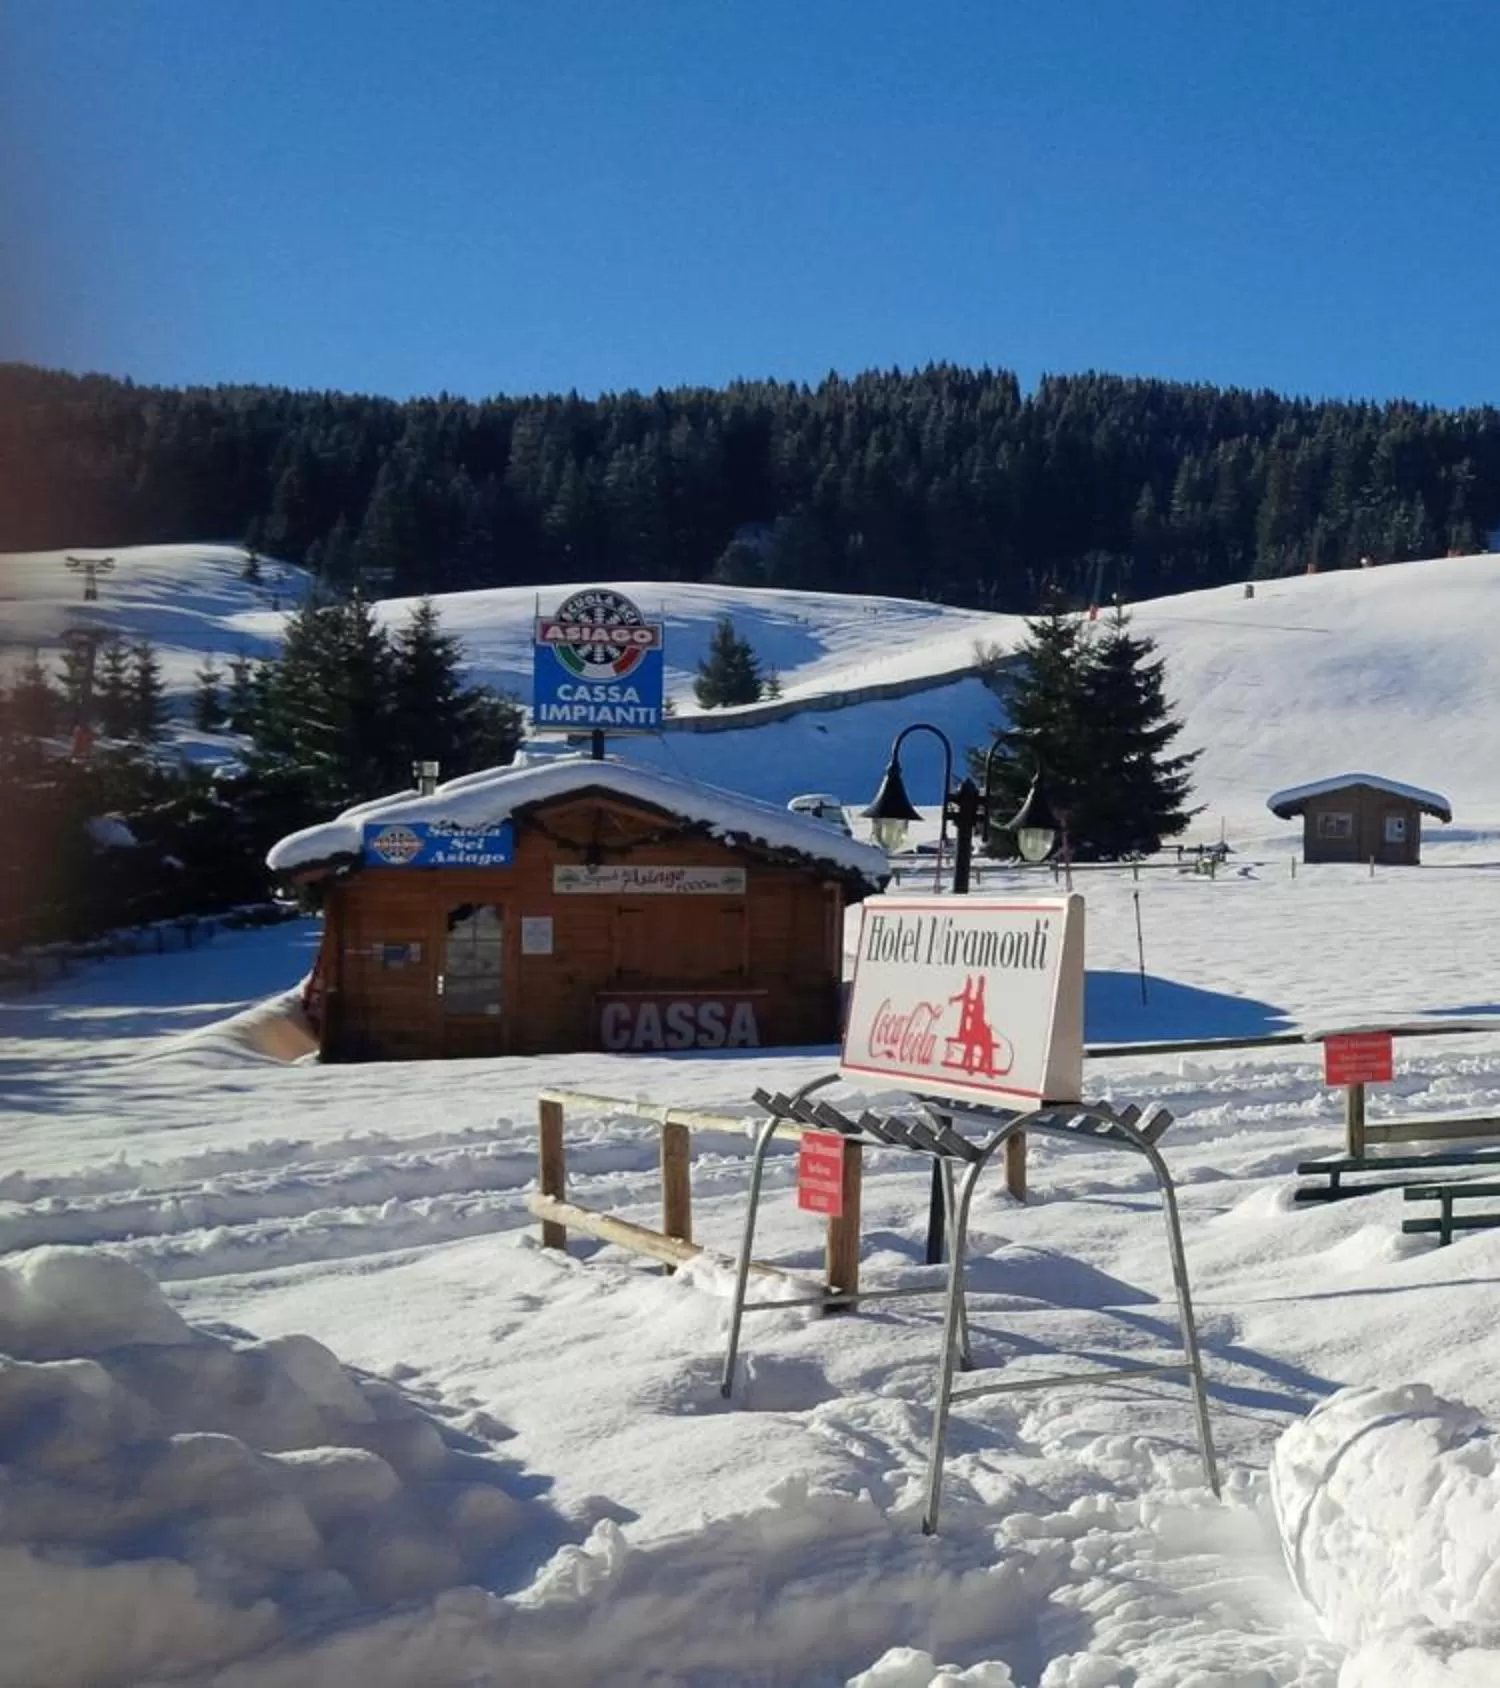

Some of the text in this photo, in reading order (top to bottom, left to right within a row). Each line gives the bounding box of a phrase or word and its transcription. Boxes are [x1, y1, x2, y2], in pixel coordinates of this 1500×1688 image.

[544, 625, 654, 643] ASIAGO
[556, 683, 641, 703] CASSA
[540, 703, 657, 724] IMPIANTI
[429, 850, 506, 865] Asiago
[866, 915, 1051, 971] Hotel Miramonti
[601, 1001, 760, 1049] CASSA
